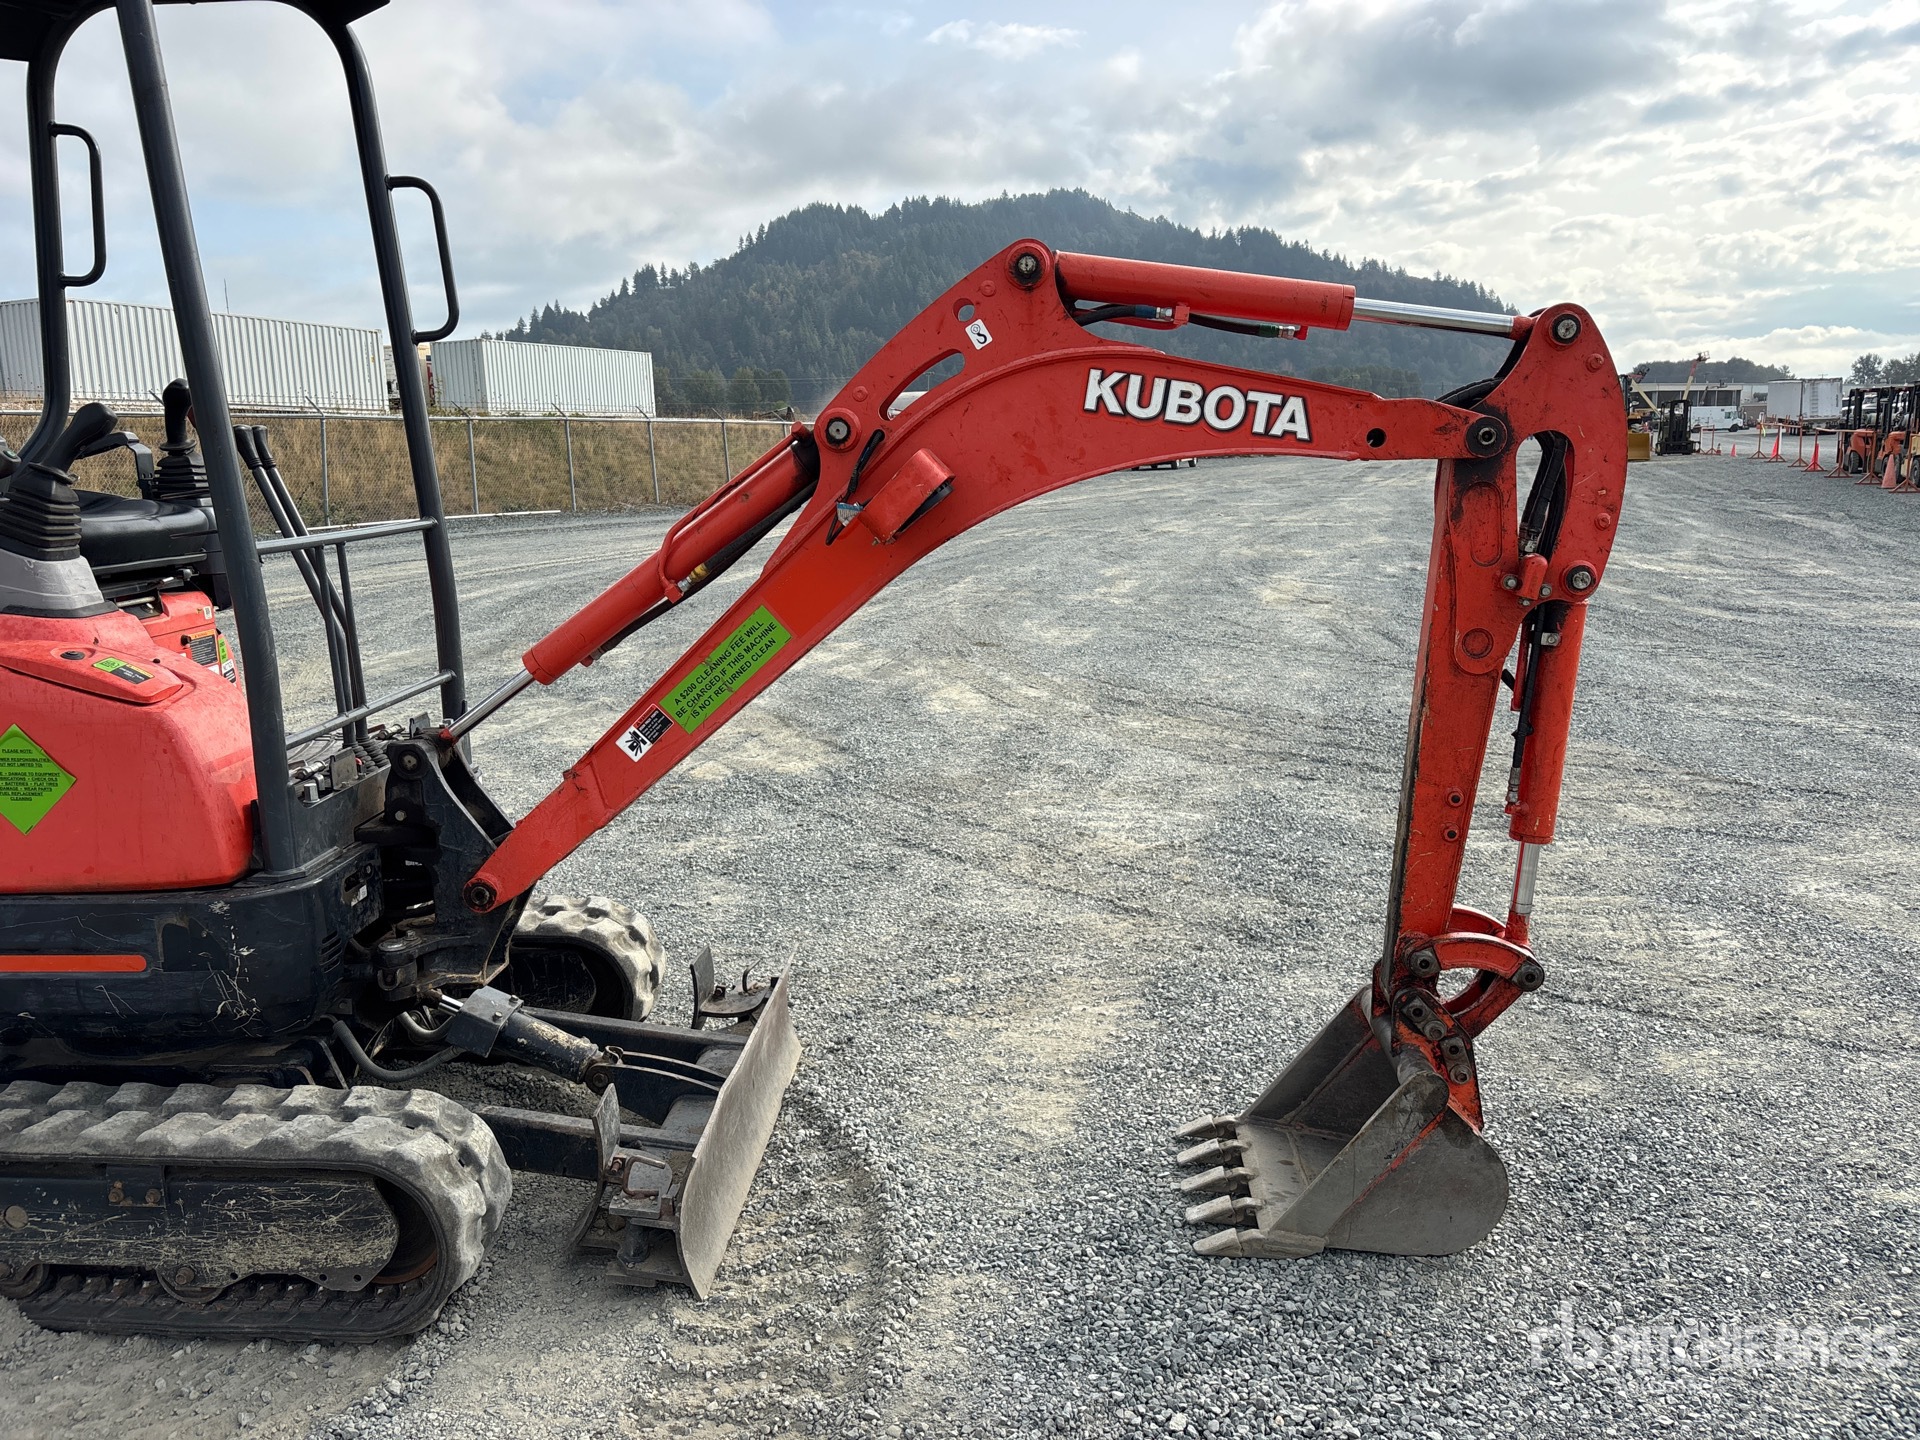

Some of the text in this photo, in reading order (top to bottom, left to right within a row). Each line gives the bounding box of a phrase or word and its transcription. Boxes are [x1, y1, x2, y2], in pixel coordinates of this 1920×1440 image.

[1082, 367, 1312, 442] KUBOTA
[674, 620, 764, 706] A $200 CLEANING FEE WILL
[675, 621, 777, 718] BE CHARGED IF THIS MACHINE
[691, 637, 777, 719] IS NOT RETURNED CLEAN
